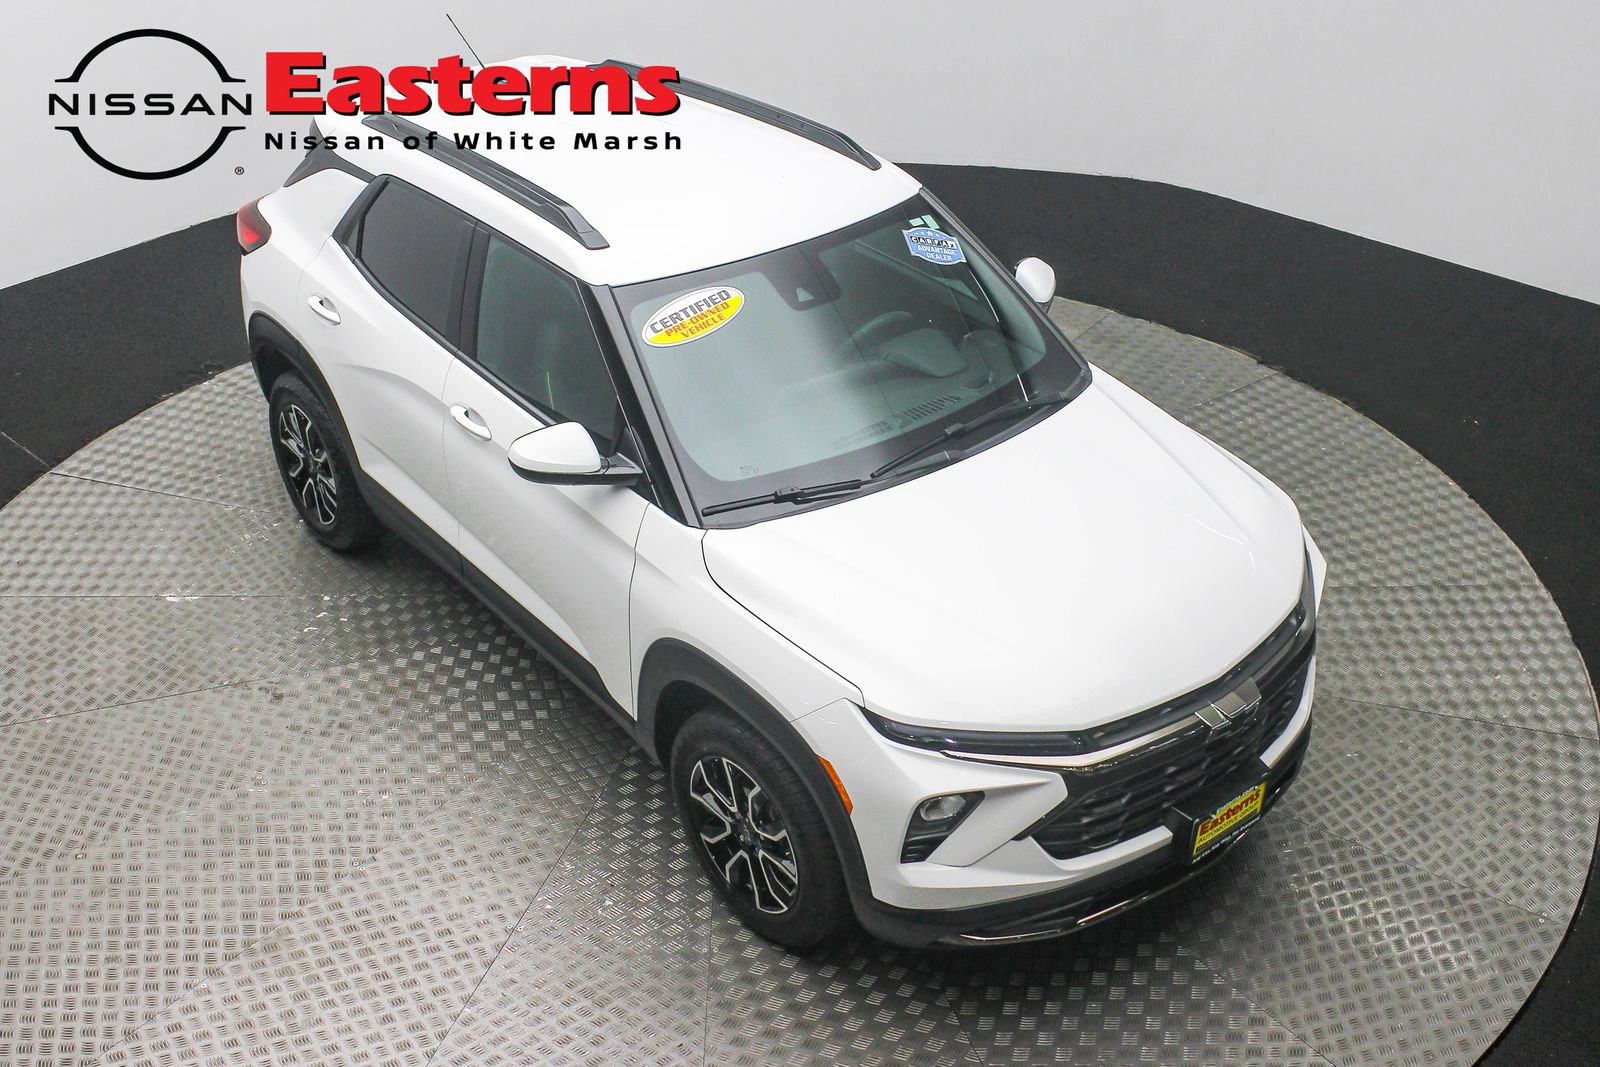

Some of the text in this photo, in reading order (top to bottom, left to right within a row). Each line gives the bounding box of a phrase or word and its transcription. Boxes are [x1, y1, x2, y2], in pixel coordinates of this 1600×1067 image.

[917, 244, 957, 255] ADVANTAGE
[926, 252, 953, 262] DEALER
[649, 289, 732, 334] CERTIFIED
[664, 301, 730, 337] PRE-OWNED
[680, 313, 726, 338] VEHICLE
[1199, 789, 1261, 837] Easterns
[1197, 814, 1239, 844] AUTOMOTIVE
